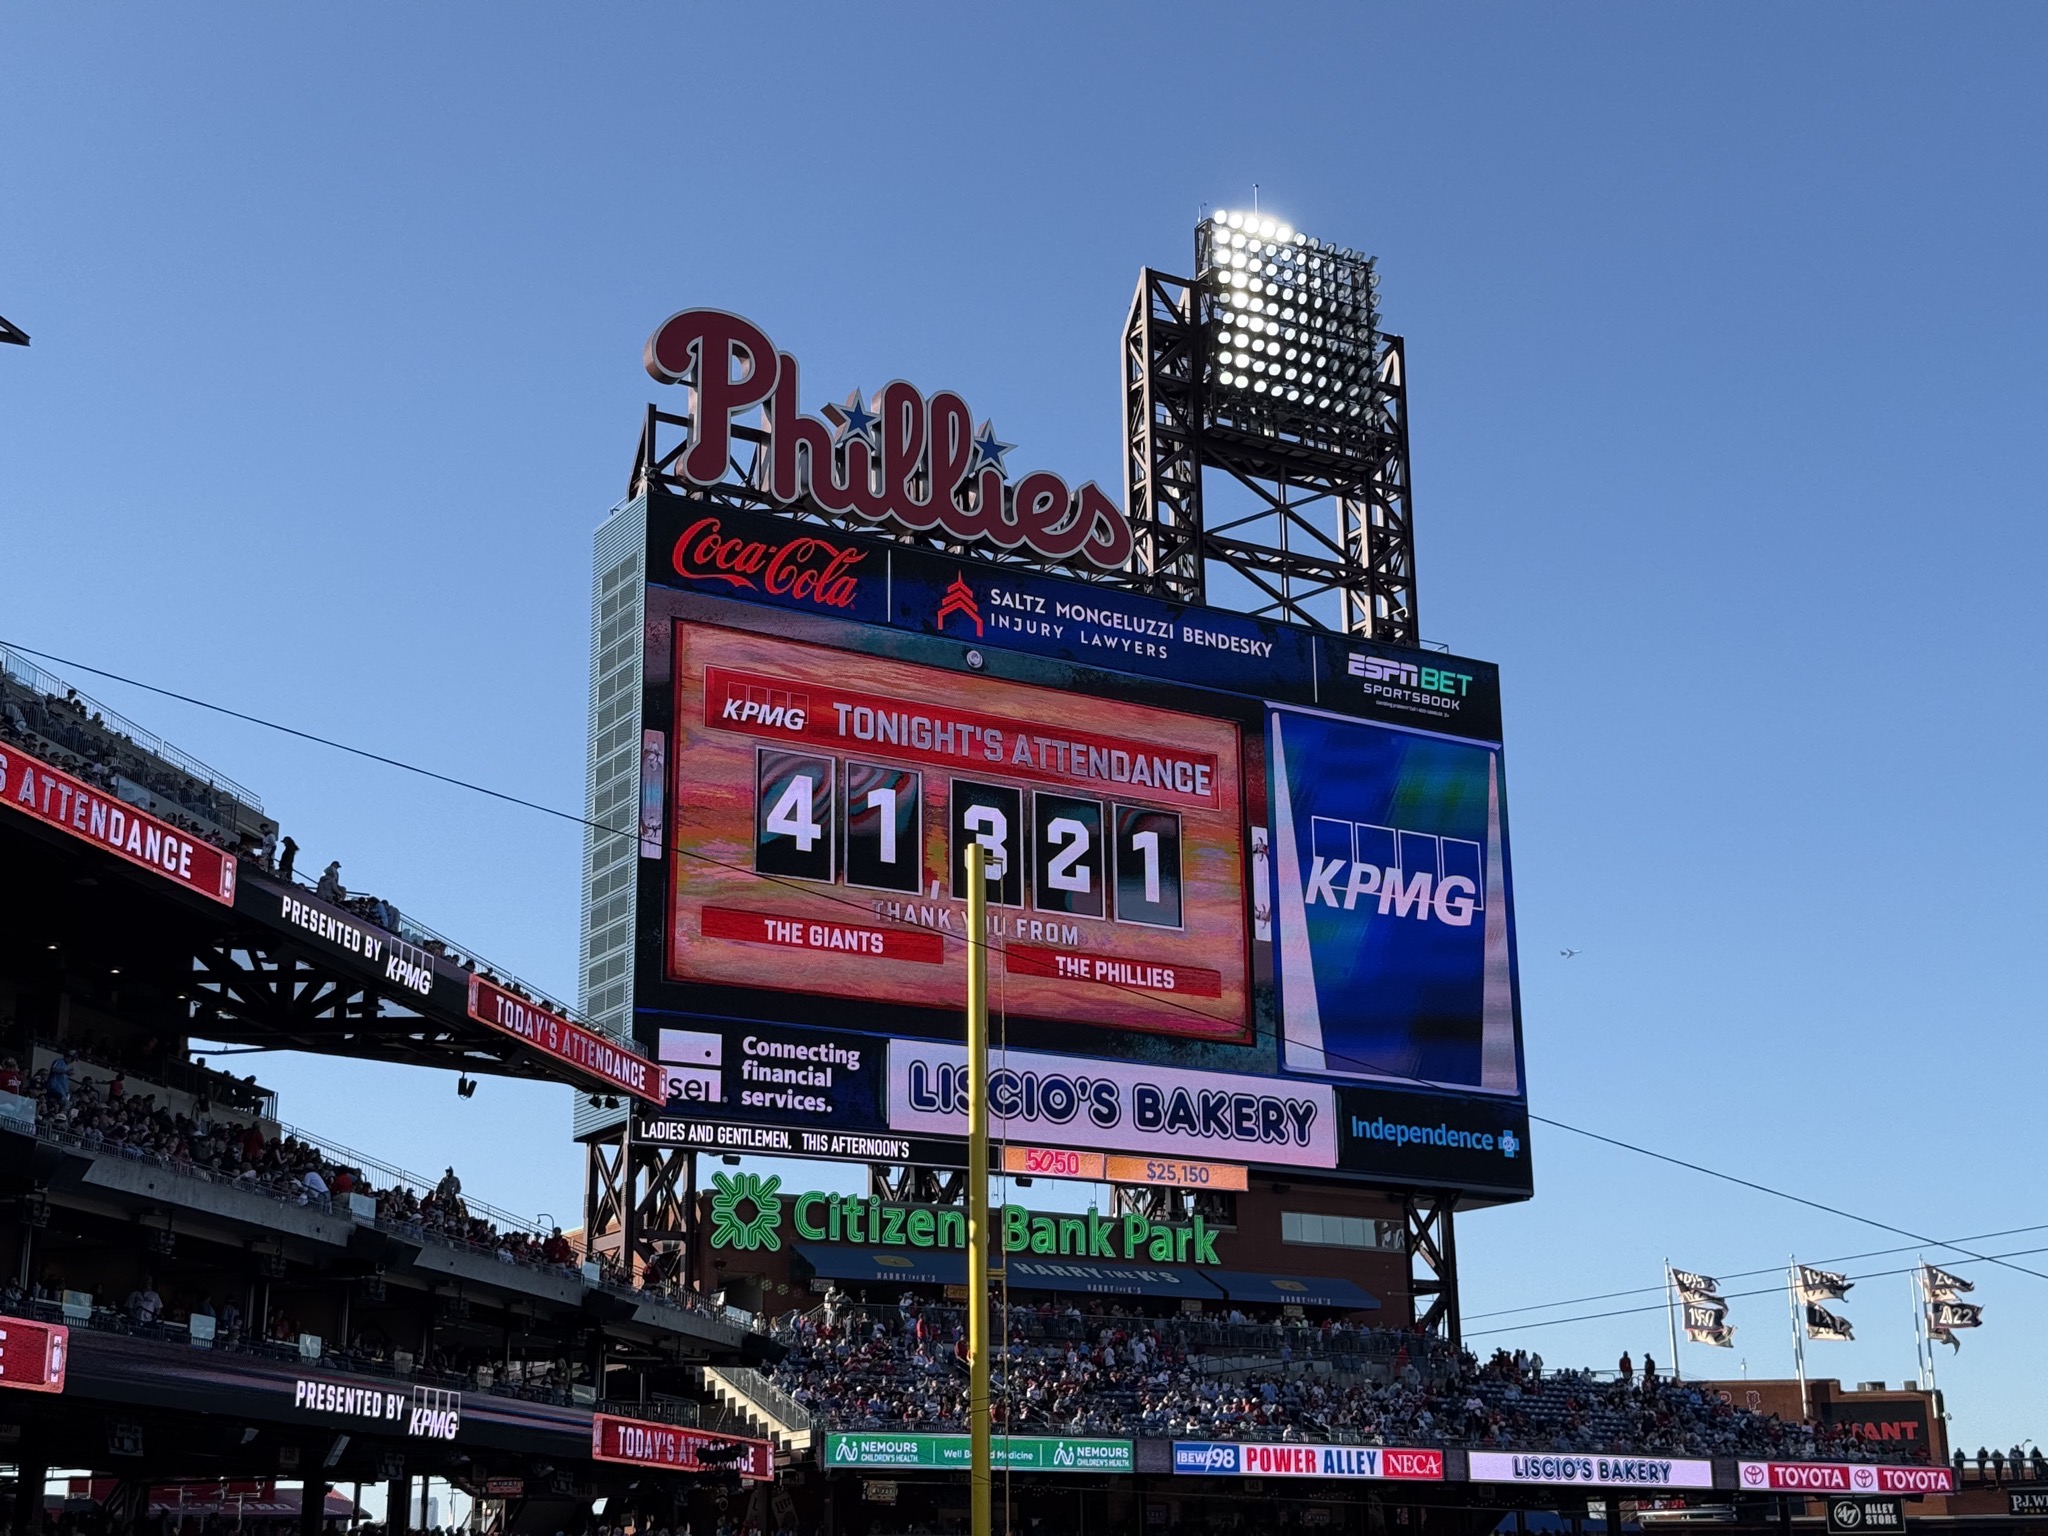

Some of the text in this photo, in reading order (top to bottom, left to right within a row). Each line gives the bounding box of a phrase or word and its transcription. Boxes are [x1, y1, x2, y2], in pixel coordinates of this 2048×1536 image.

[645, 307, 1134, 570] Phillies
[672, 517, 868, 610] Coca-Cola
[990, 588, 1273, 658] SALTZ MONGELUZZI BENDESKY
[991, 613, 1168, 659] INJURY LAWYERS
[1363, 683, 1460, 711] SPORTSBOOK
[1421, 667, 1473, 696] BET
[723, 699, 1211, 797] KPMG TONIGHT'S ATTENDANCE
[18, 766, 194, 880] ATTENDANCE
[1305, 856, 1477, 927] KPMG
[764, 920, 884, 955] THE GIANTS
[872, 899, 951, 929] THANK
[1016, 918, 1079, 946] FROM
[281, 895, 432, 996] PRESENTED BY KPMG
[1055, 956, 1175, 990] THE PHILLIES
[496, 995, 646, 1091] TODAY'S ATTENDANCE
[742, 1036, 860, 1070] Connecting
[742, 1060, 832, 1088] financial
[741, 1087, 832, 1113] services.
[1133, 1082, 1317, 1146] BAKERY
[641, 1120, 909, 1158] LADIES AND GENTLEMEN, THIS AFTERNOON'S
[1352, 1115, 1493, 1151] Independence
[1147, 1161, 1209, 1184] $25,150
[795, 1190, 1221, 1265] Citizen Bank Park
[1013, 1262, 1181, 1284] HARRY THE K'S
[295, 1380, 459, 1440] PRESENTED BY KPMG
[618, 1426, 675, 1462] TODAY'S
[861, 1441, 918, 1453] NEMOURS
[1838, 1421, 1919, 1440] ANT
[861, 1454, 918, 1462] CHILDREN'S HEALTH
[944, 1449, 962, 1458] Well
[1077, 1446, 1129, 1458] NEMOURS
[1246, 1447, 1377, 1474] POWER ALLEY
[1388, 1453, 1441, 1475] NECA
[1512, 1455, 1673, 1484] LISCIO'S BAKERY
[1774, 1466, 1845, 1487] TOYOTA
[1883, 1469, 1950, 1490] TOYOTA
[1865, 1503, 1894, 1514] ALLEY
[1865, 1514, 1897, 1525] STORE
